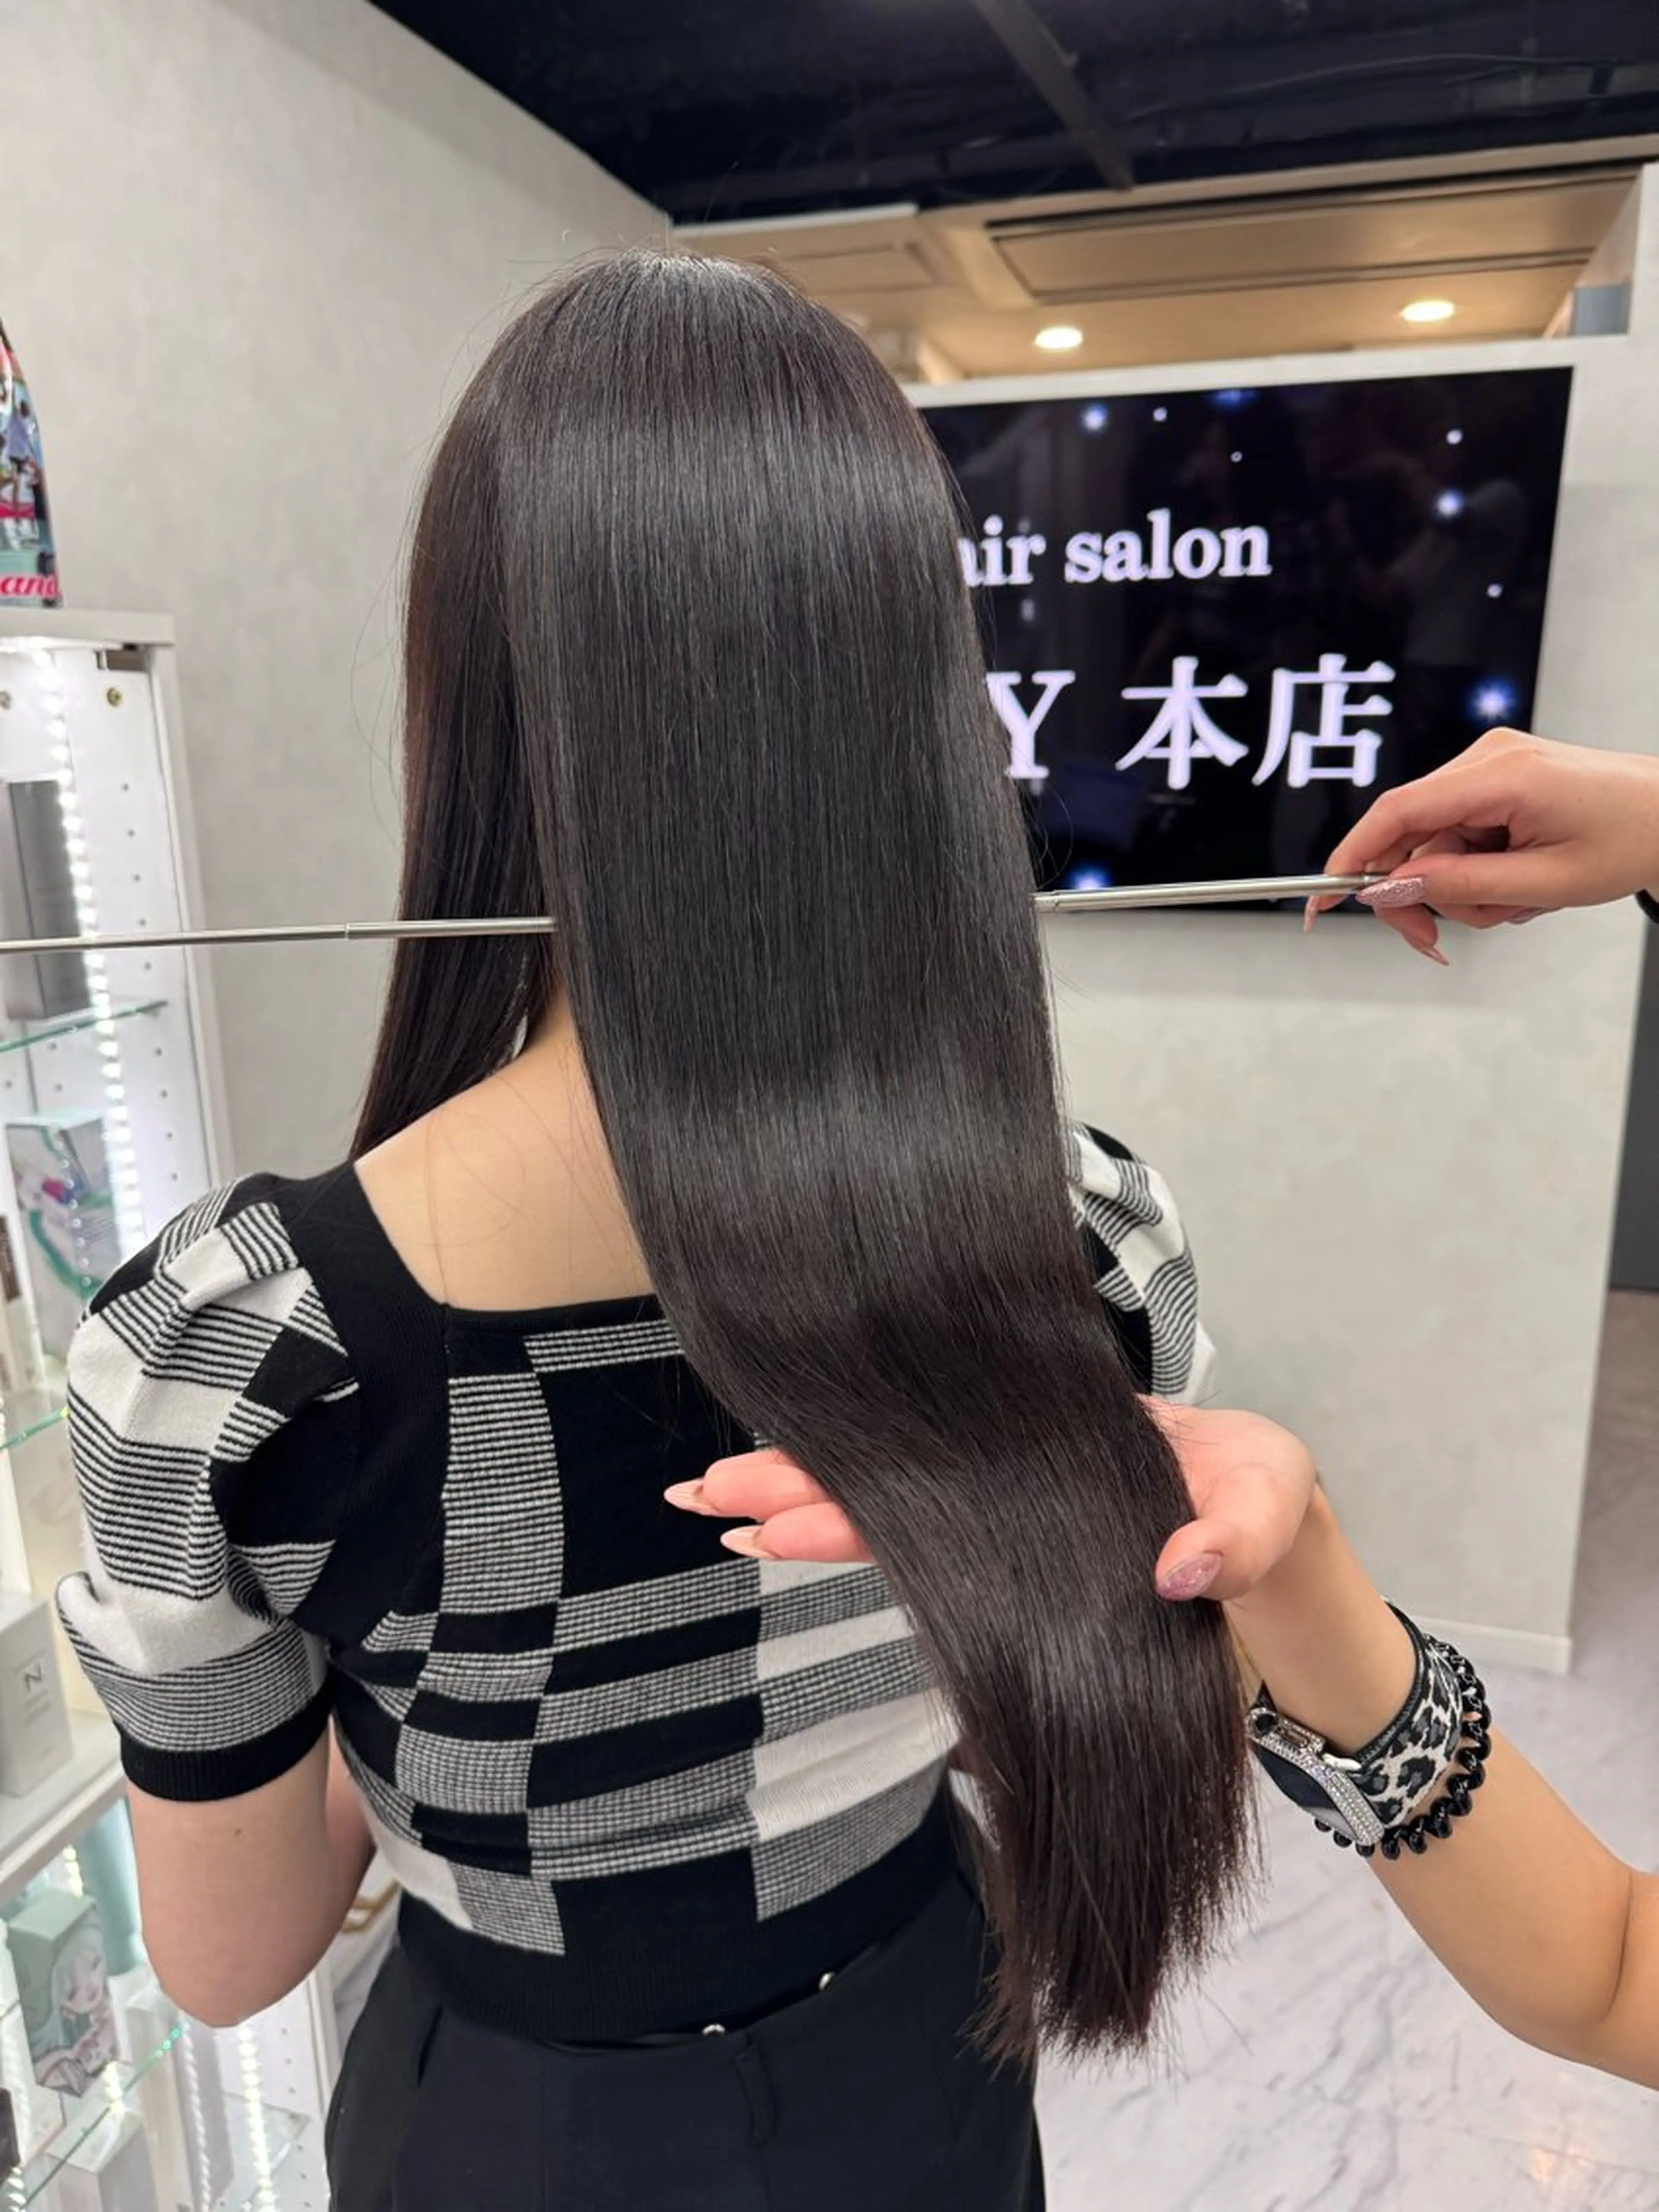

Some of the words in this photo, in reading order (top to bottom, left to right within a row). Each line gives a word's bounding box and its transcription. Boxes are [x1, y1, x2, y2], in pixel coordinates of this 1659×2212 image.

[1064, 508, 1272, 583] salon
[985, 670, 1076, 779] Y
[1115, 653, 1395, 790] 本店
